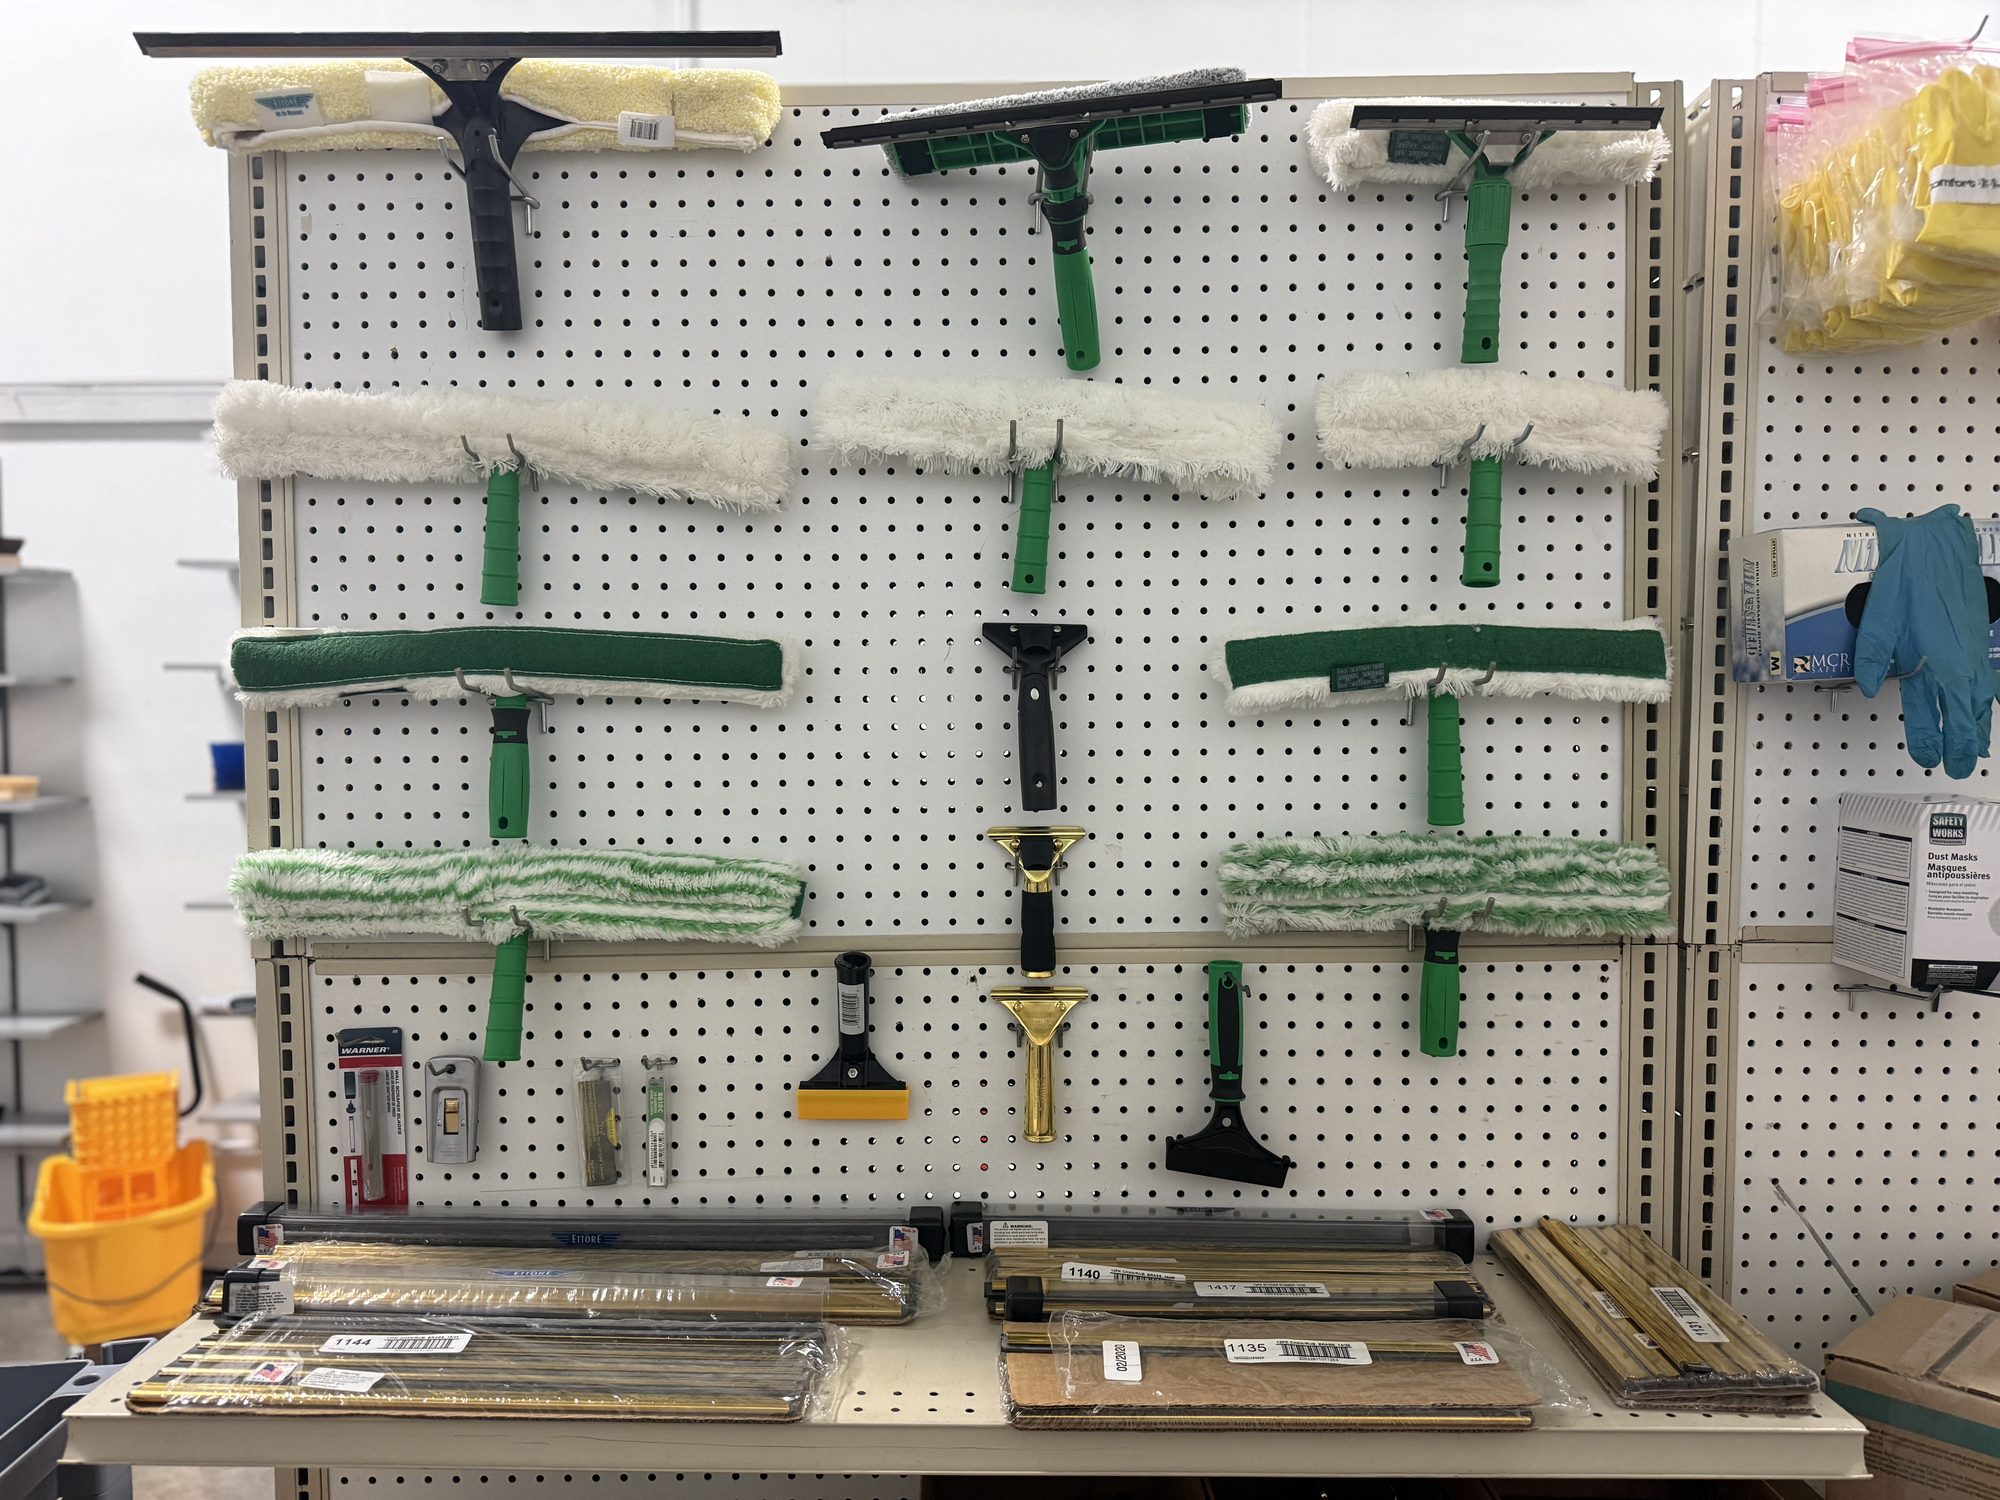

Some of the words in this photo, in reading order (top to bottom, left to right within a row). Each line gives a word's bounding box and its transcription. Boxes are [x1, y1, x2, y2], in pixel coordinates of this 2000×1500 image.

[1930, 178, 1976, 191] omfort
[1771, 656, 1779, 671] M
[1812, 653, 1850, 667] MCR
[1932, 816, 1963, 826] SAFETY
[1932, 828, 1963, 838] WORKS
[1928, 852, 1948, 860] Dust
[1951, 853, 1978, 861] Masks
[1927, 863, 1967, 873] Masques
[1927, 871, 1990, 880] antipoussières
[572, 1234, 601, 1243] ETTORE
[1069, 1267, 1100, 1280] 1140
[336, 1338, 372, 1346] 1144
[1228, 1343, 1267, 1353] 1135
[1114, 1344, 1127, 1372] 02/2020
